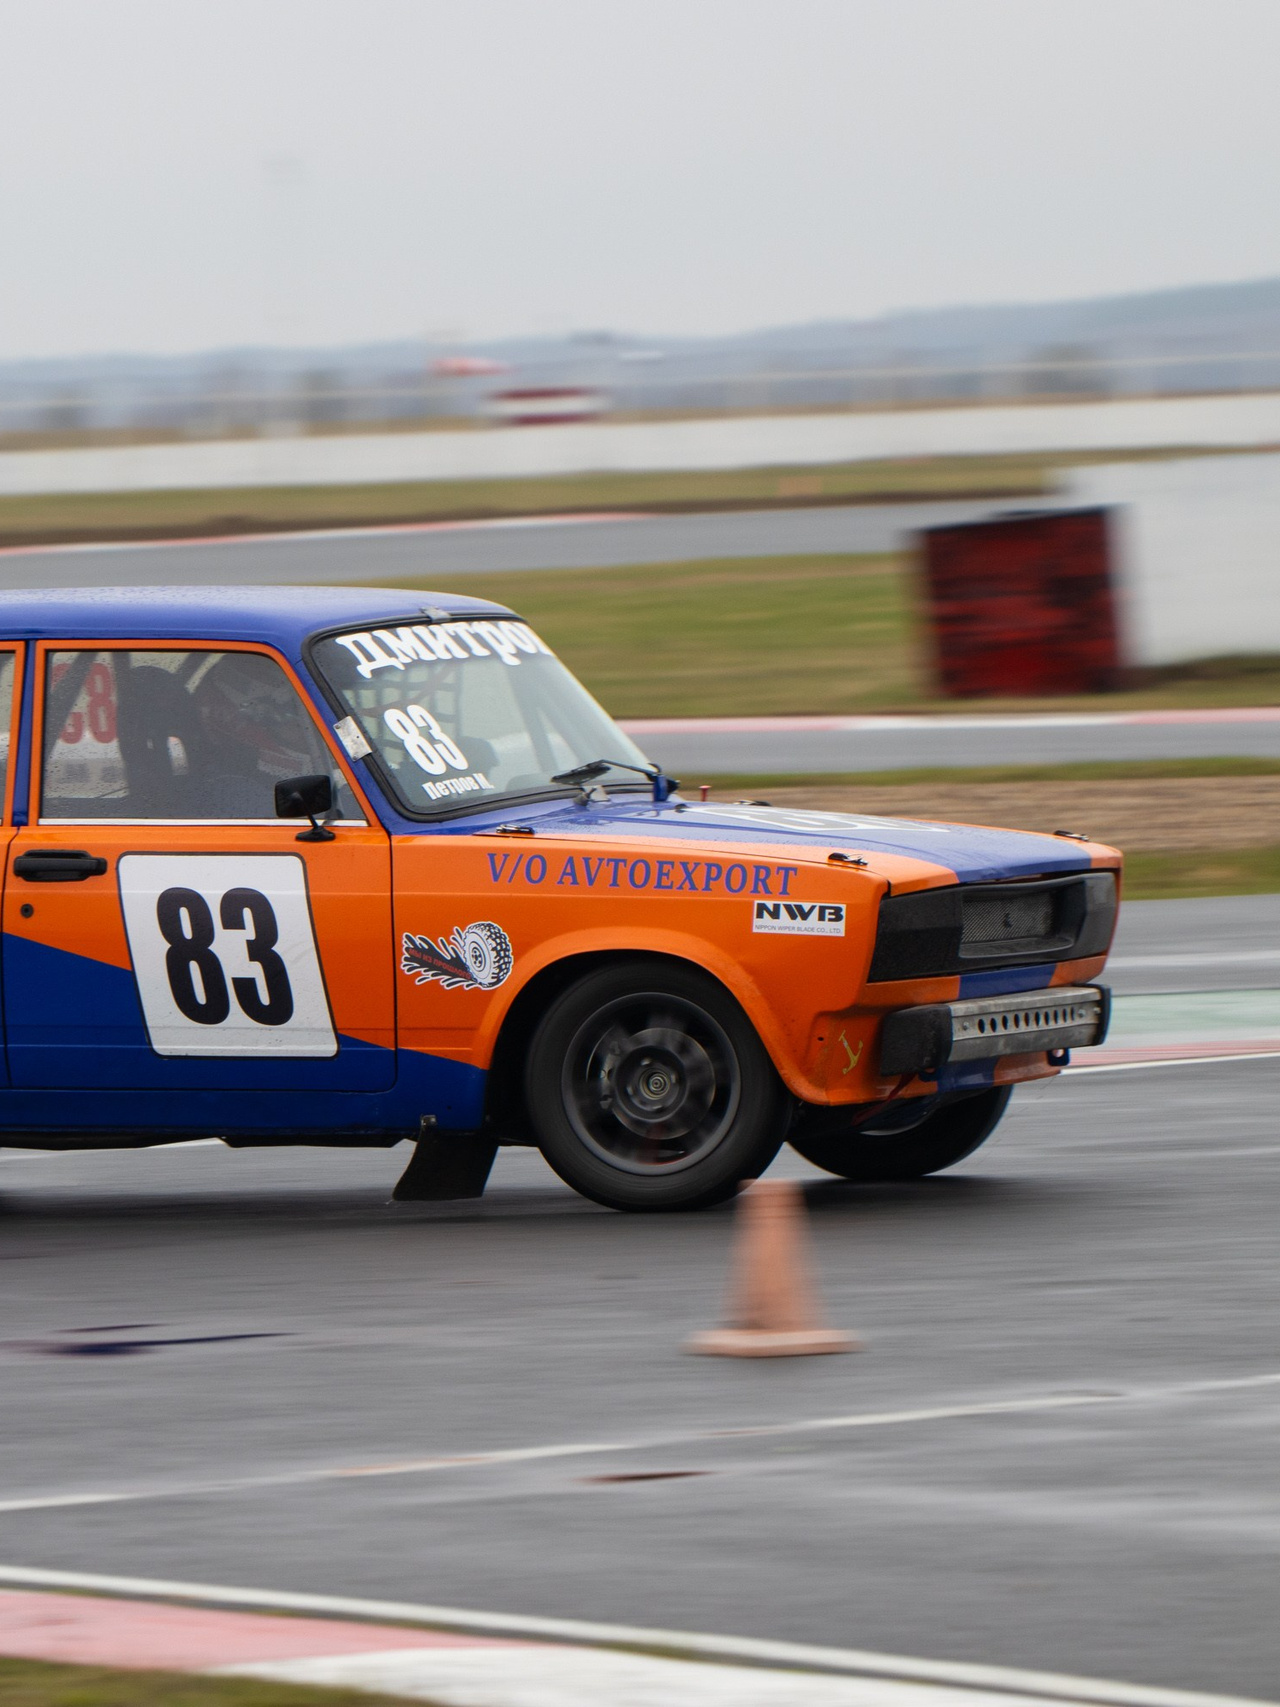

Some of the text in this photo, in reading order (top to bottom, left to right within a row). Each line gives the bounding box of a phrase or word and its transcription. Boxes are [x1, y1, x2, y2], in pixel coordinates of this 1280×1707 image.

[384, 705, 468, 775] 83
[421, 775, 480, 800] Петров
[487, 853, 798, 896] V/O AVTOEXPORT
[756, 902, 844, 922] NWB
[157, 887, 294, 1026] 83
[423, 953, 433, 963] ИЗ
[433, 958, 472, 980] ПРОШЛОГО
